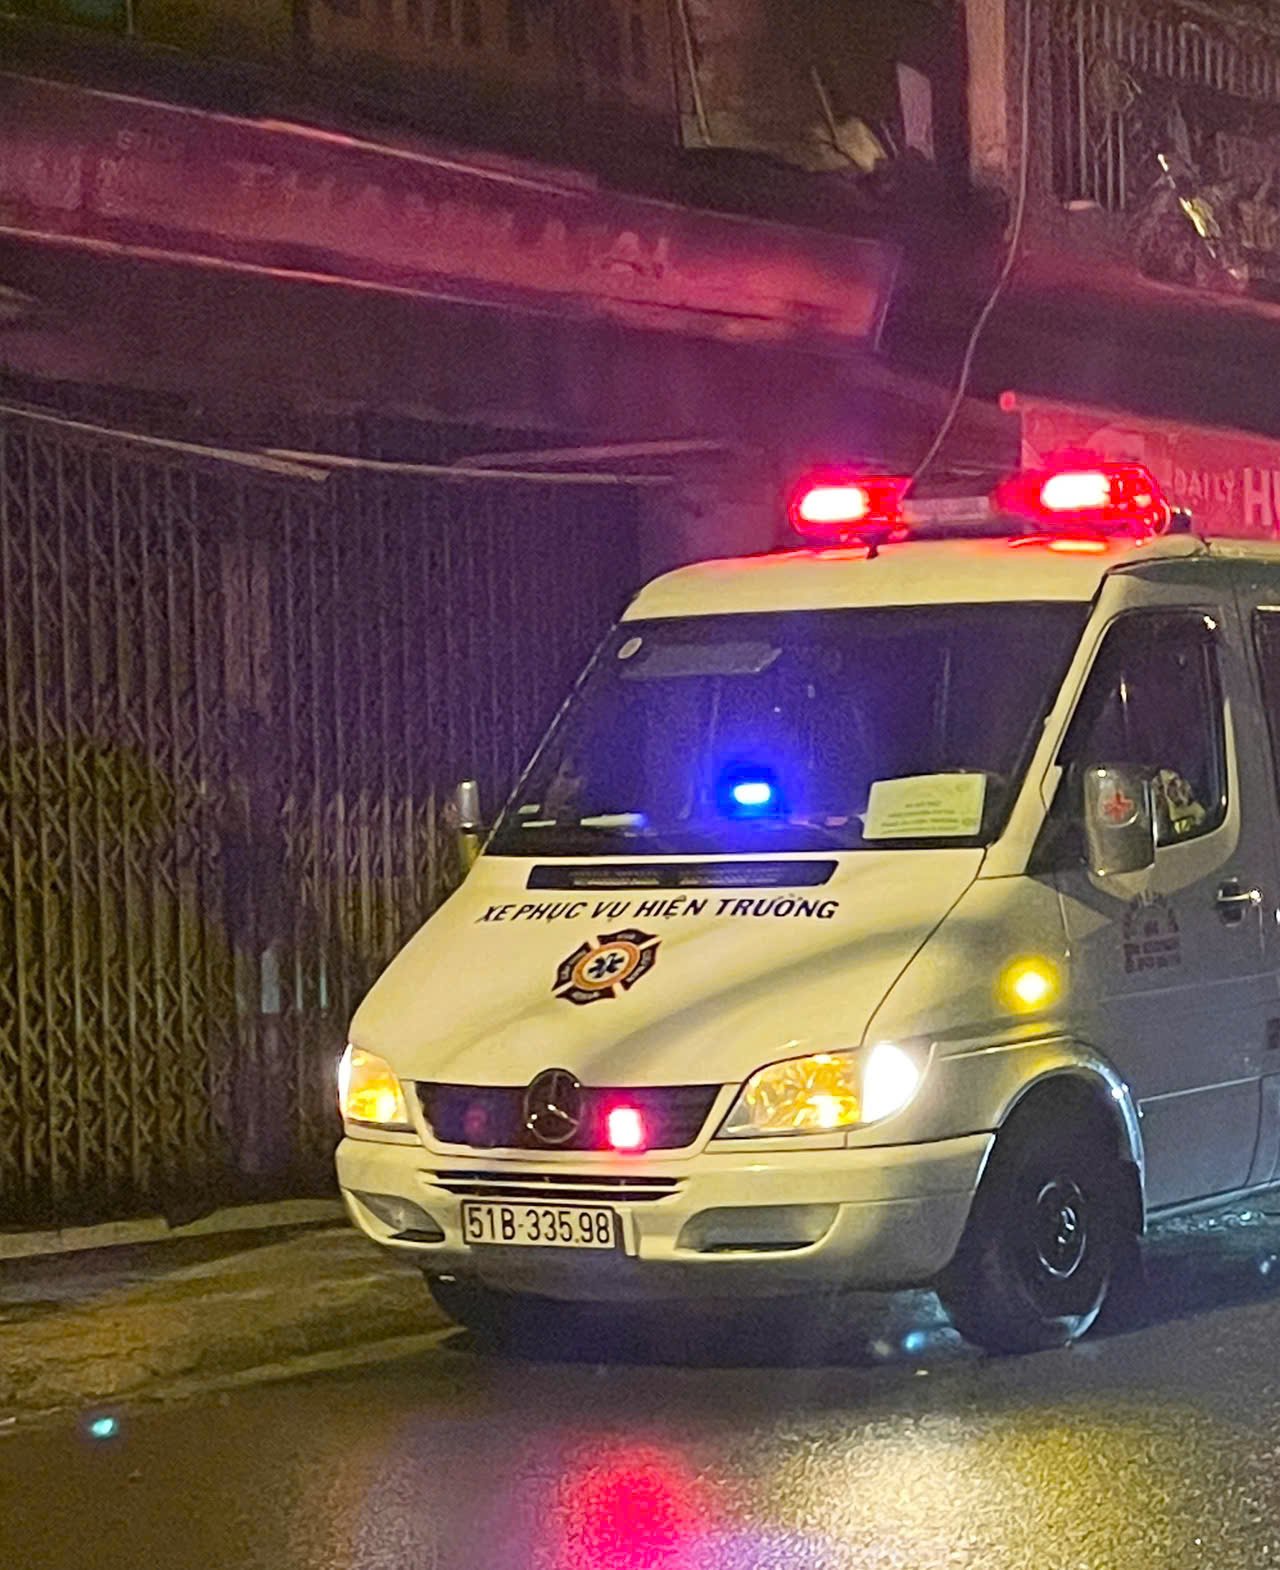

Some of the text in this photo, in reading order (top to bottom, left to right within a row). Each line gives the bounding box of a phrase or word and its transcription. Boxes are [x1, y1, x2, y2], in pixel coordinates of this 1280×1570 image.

[474, 893, 840, 924] XE PHỤC VỤ HIỆN TRƯỜNG
[468, 1207, 610, 1243] 51B-335.98
